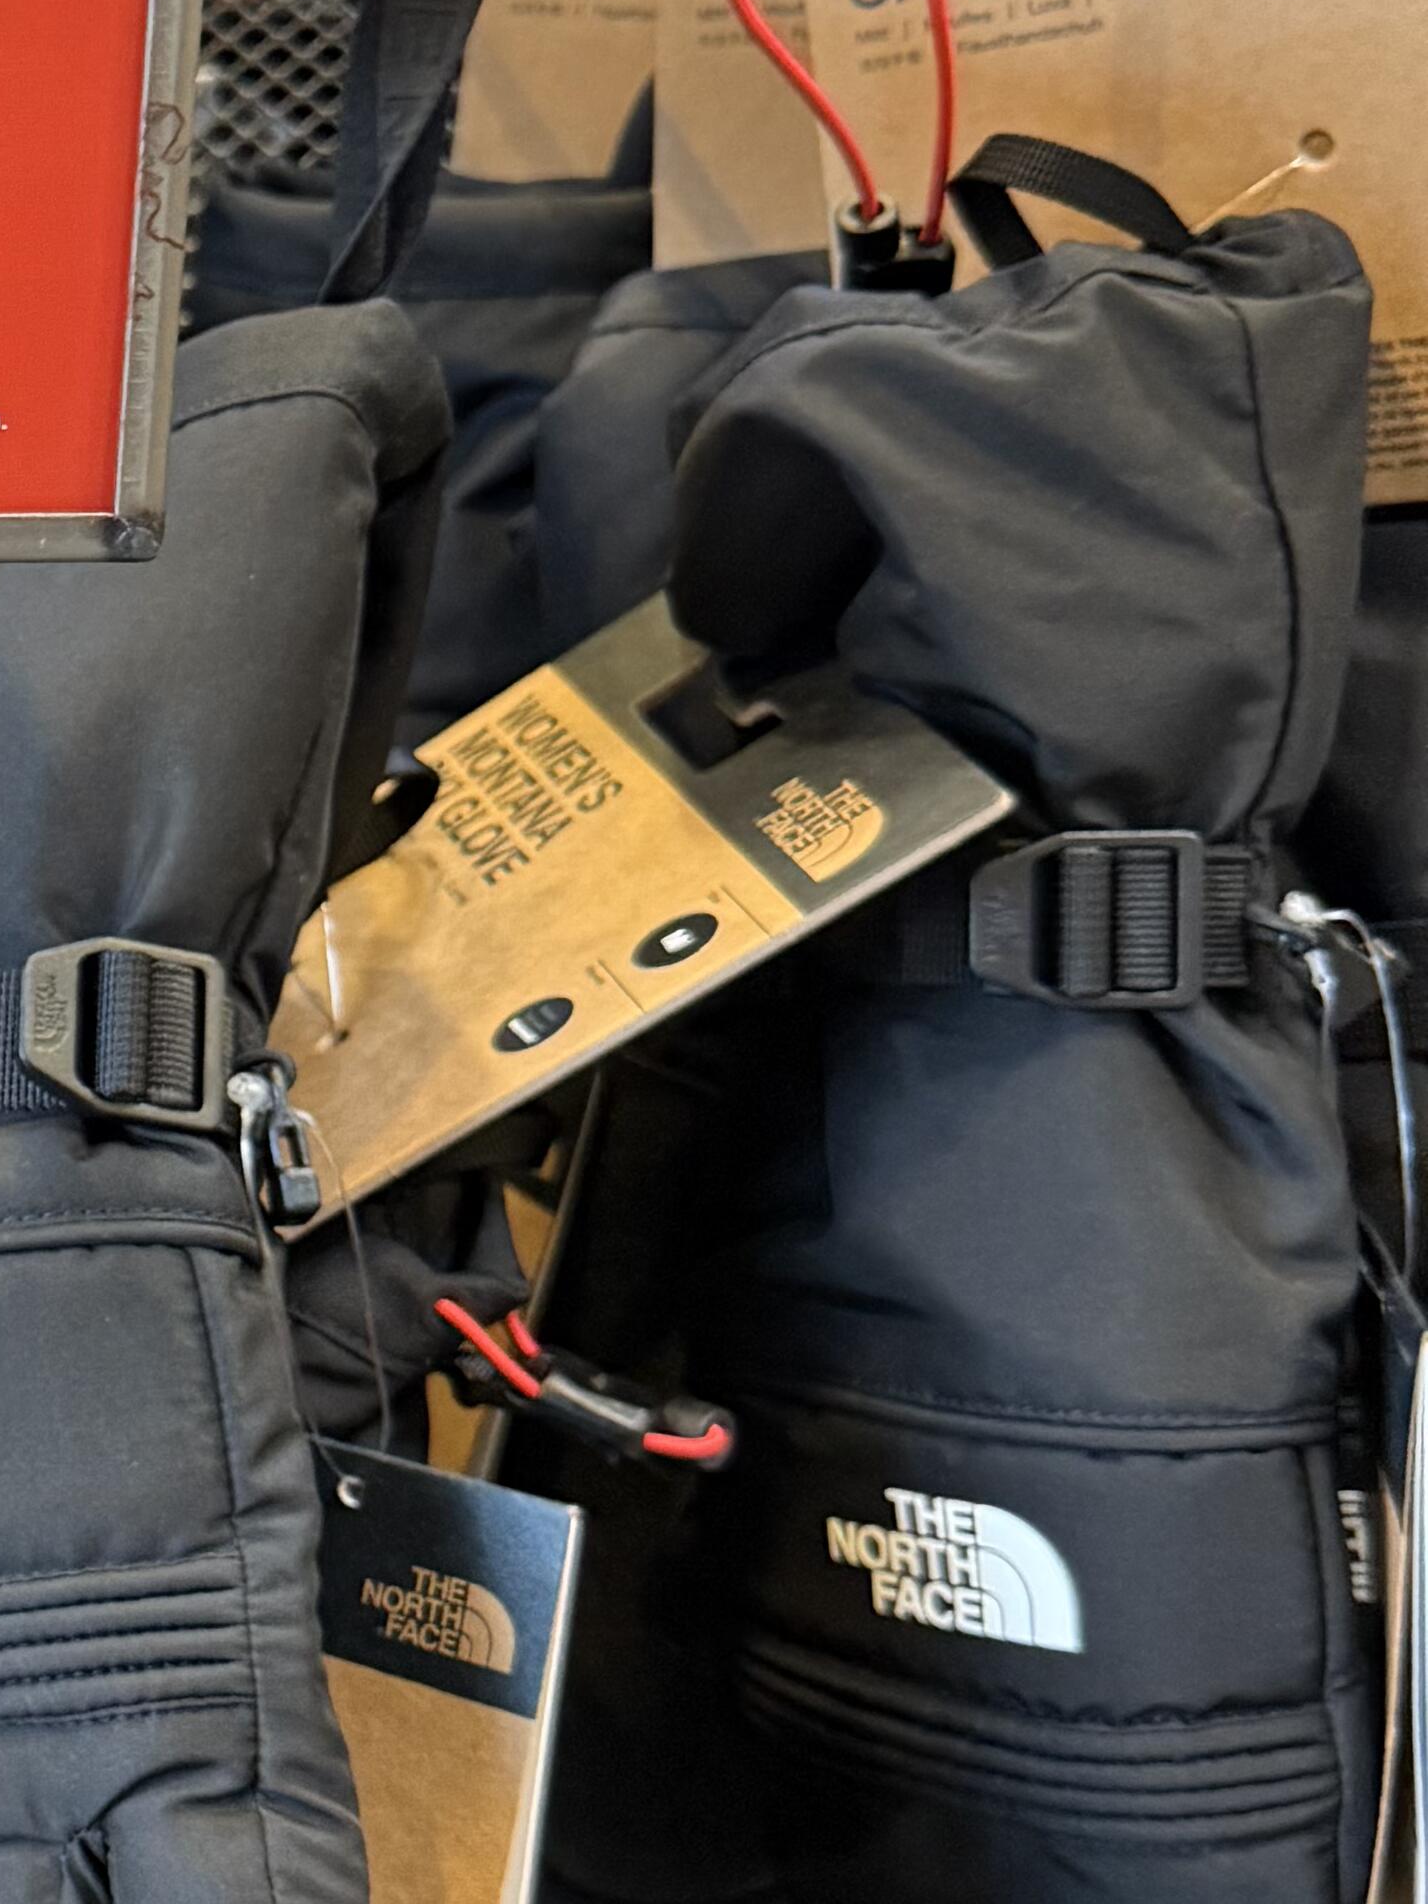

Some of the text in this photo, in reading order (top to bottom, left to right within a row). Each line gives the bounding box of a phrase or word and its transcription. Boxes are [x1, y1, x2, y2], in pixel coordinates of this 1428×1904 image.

[448, 726, 574, 852] MONTANA
[496, 693, 623, 813] WOMEN'S
[435, 796, 531, 887] GLOVE
[883, 1486, 978, 1545] THE
[411, 1564, 468, 1607] THE
[826, 1515, 980, 1589] NORTH
[360, 1577, 464, 1634] NORTH
[385, 1612, 461, 1659] FACE
[871, 1567, 985, 1639] FACE
